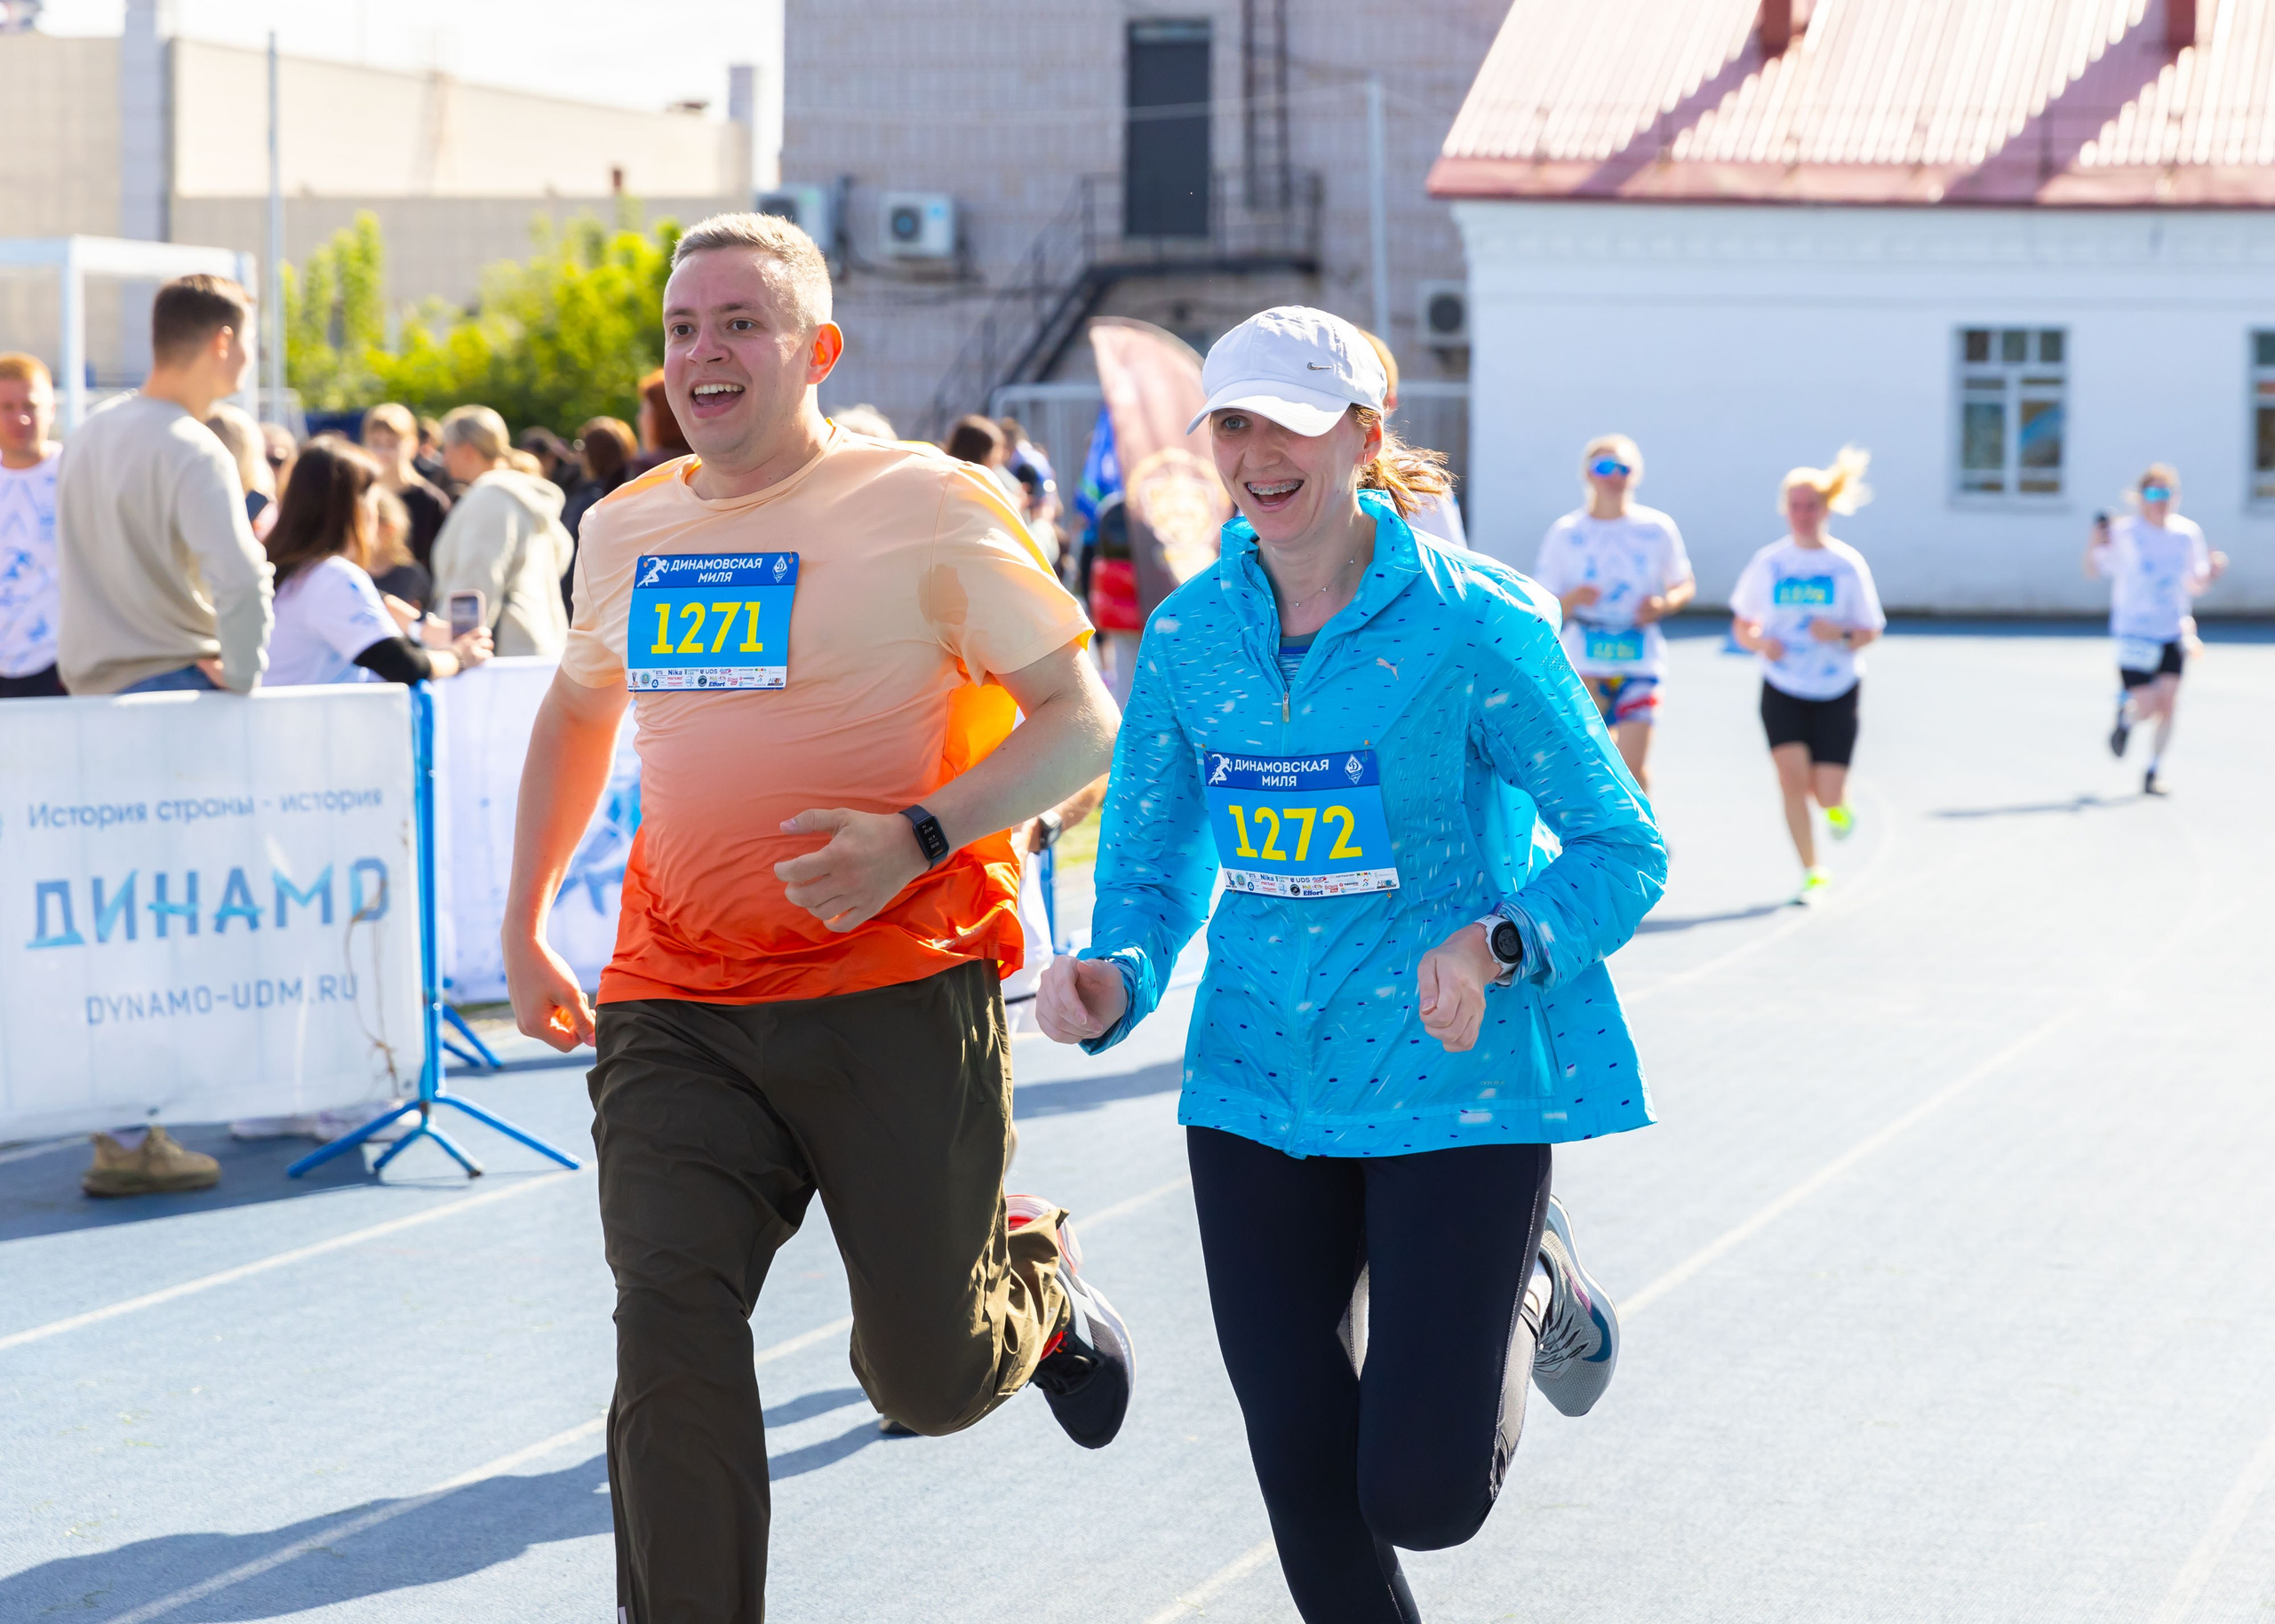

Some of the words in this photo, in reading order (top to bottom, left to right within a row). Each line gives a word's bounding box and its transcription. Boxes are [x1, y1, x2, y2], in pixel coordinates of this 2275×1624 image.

[670, 557, 763, 572] ДИНАМОВСКАЯ
[697, 571, 733, 584] МИЛЯ
[651, 601, 763, 655] 1271
[1234, 759, 1329, 772] ДИНАМОВСКАЯ
[1262, 776, 1297, 787] МИЛЯ
[28, 801, 147, 831] История
[156, 794, 255, 824] страны
[281, 788, 382, 813] история
[1228, 804, 1363, 862] 1272
[26, 857, 389, 949] ДИНАМО
[86, 974, 359, 1025] DYNAMO-UDM.RU
